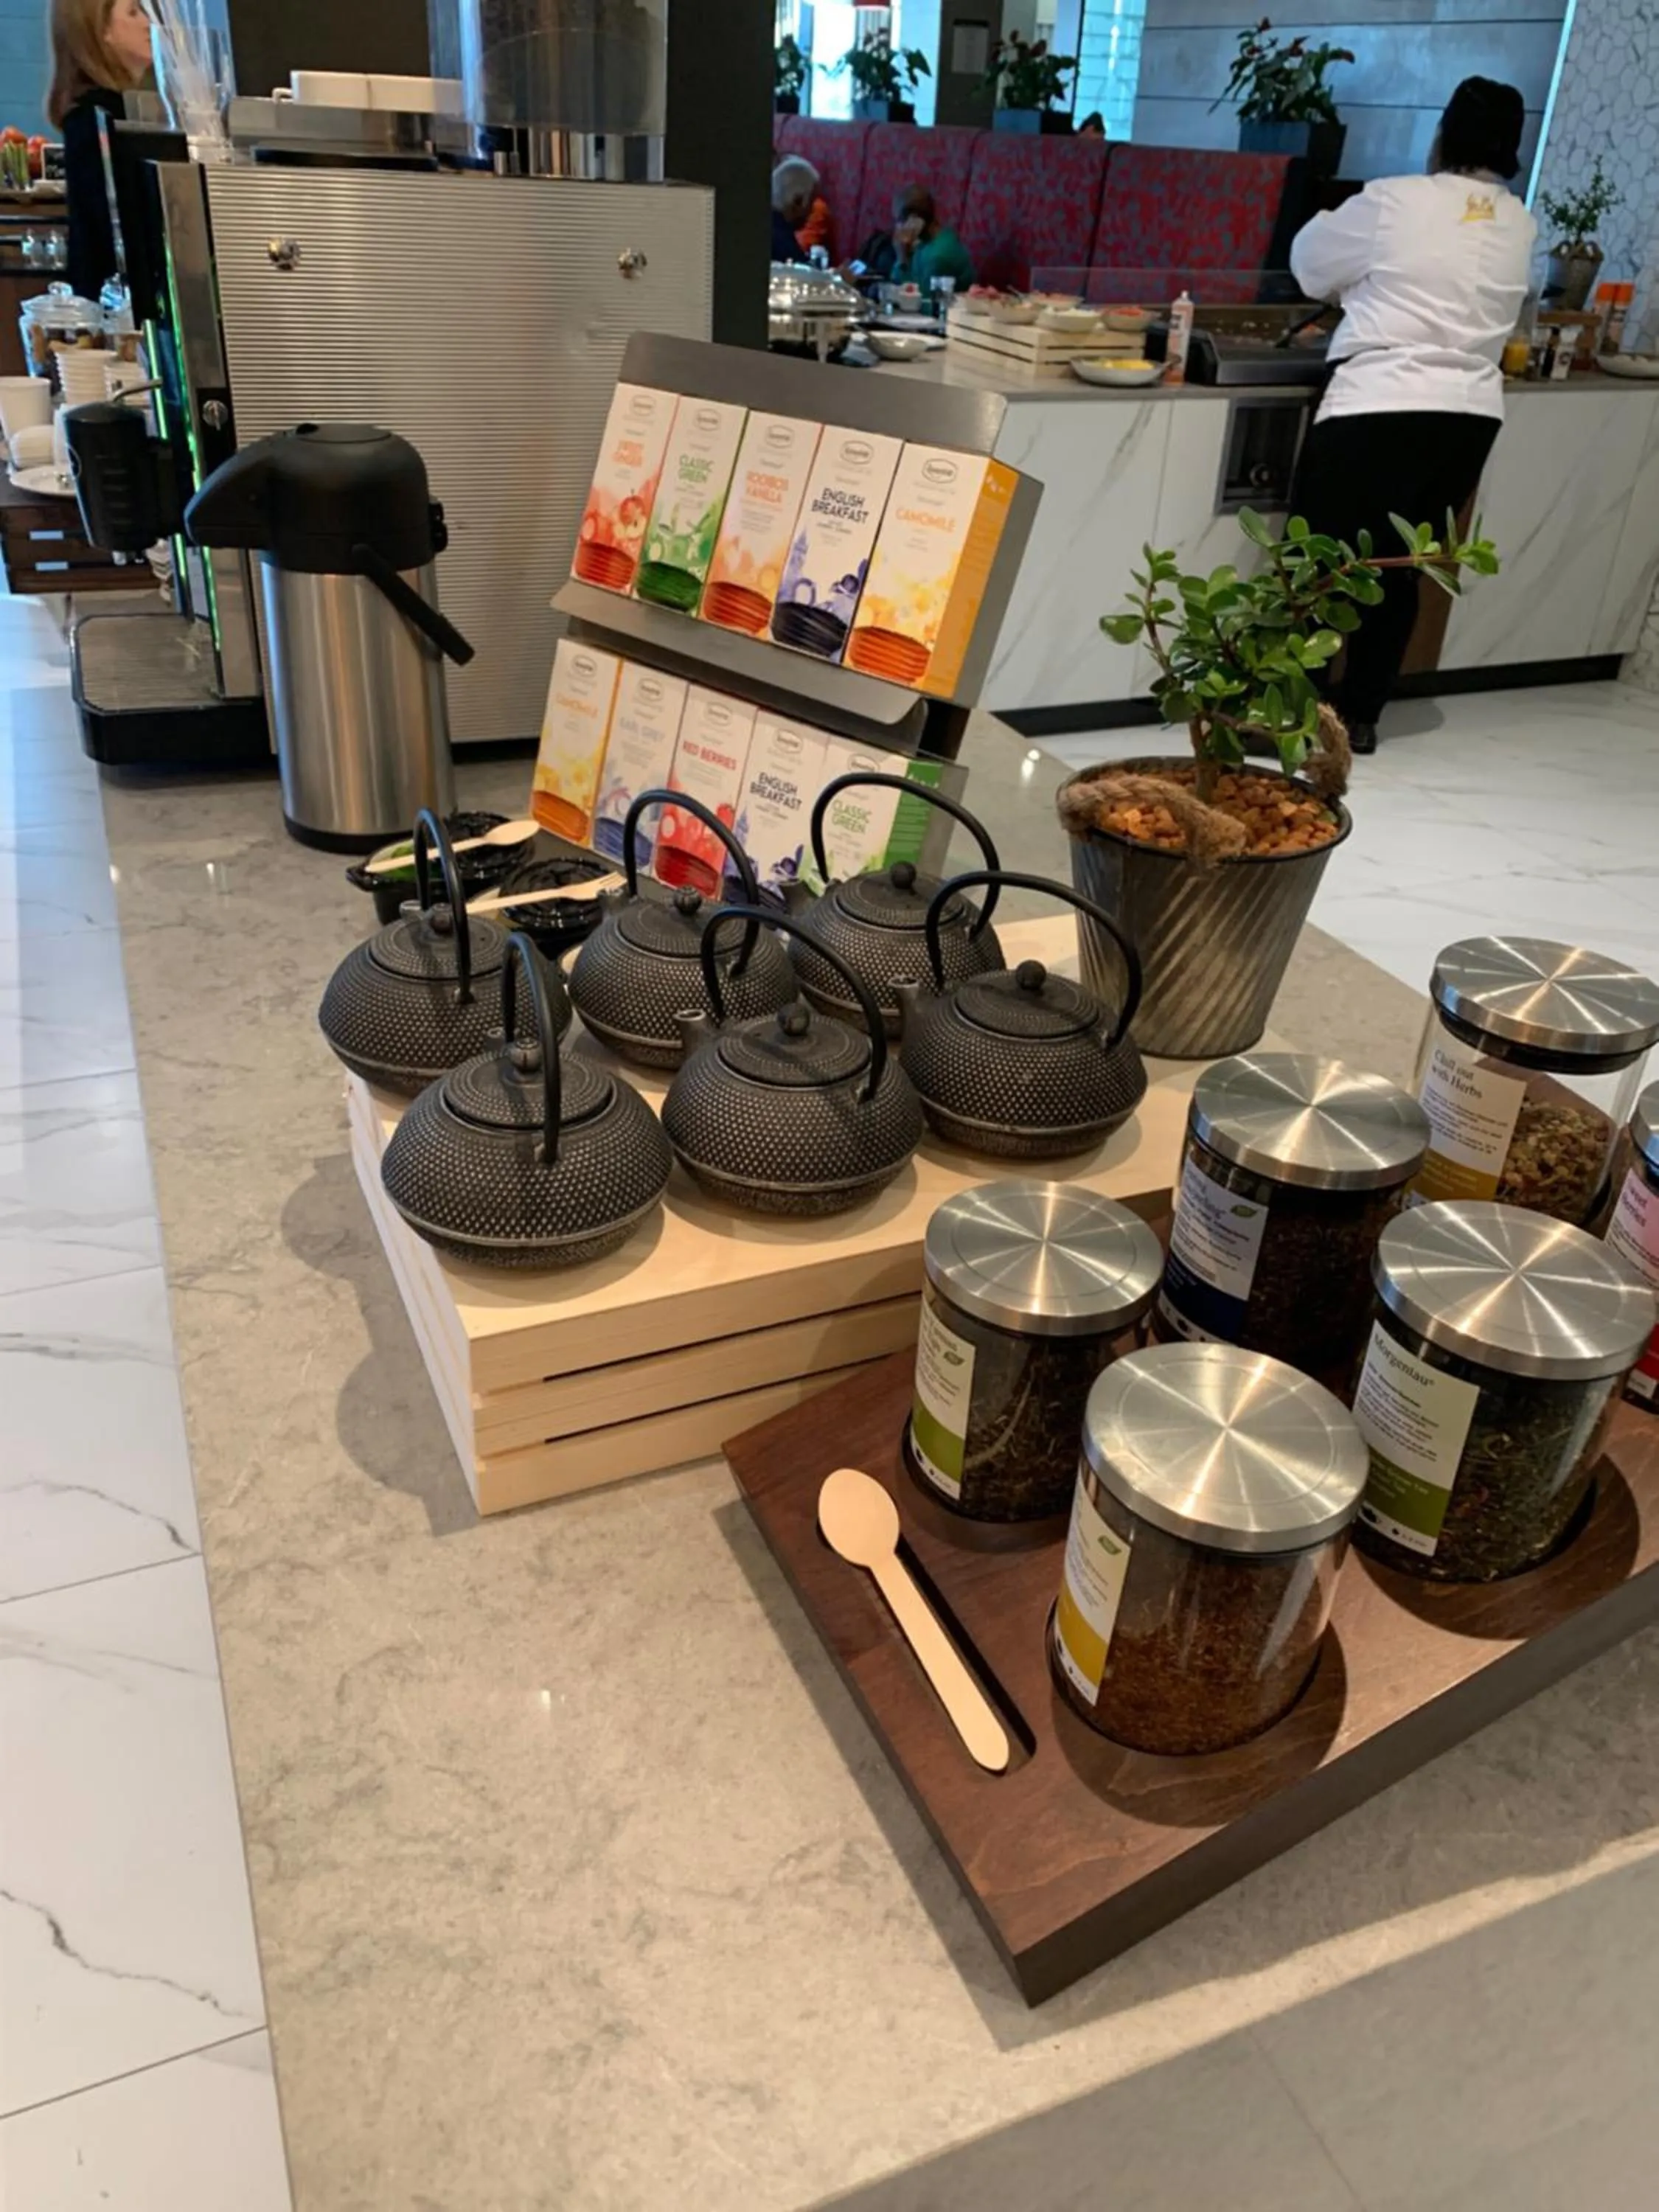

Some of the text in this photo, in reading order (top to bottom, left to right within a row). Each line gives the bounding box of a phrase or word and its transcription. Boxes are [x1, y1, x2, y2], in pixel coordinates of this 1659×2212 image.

[679, 453, 714, 472] CLASSIC
[822, 487, 866, 507] ENGLISH
[811, 499, 869, 524] BREAKFAST
[683, 740, 737, 771] RED BERRIES
[759, 772, 798, 795] ENGLISH
[750, 782, 802, 811] BREAKFAST
[832, 799, 872, 824] CLASSIC
[832, 813, 866, 834] GREEN
[1451, 1076, 1482, 1099] Herbs
